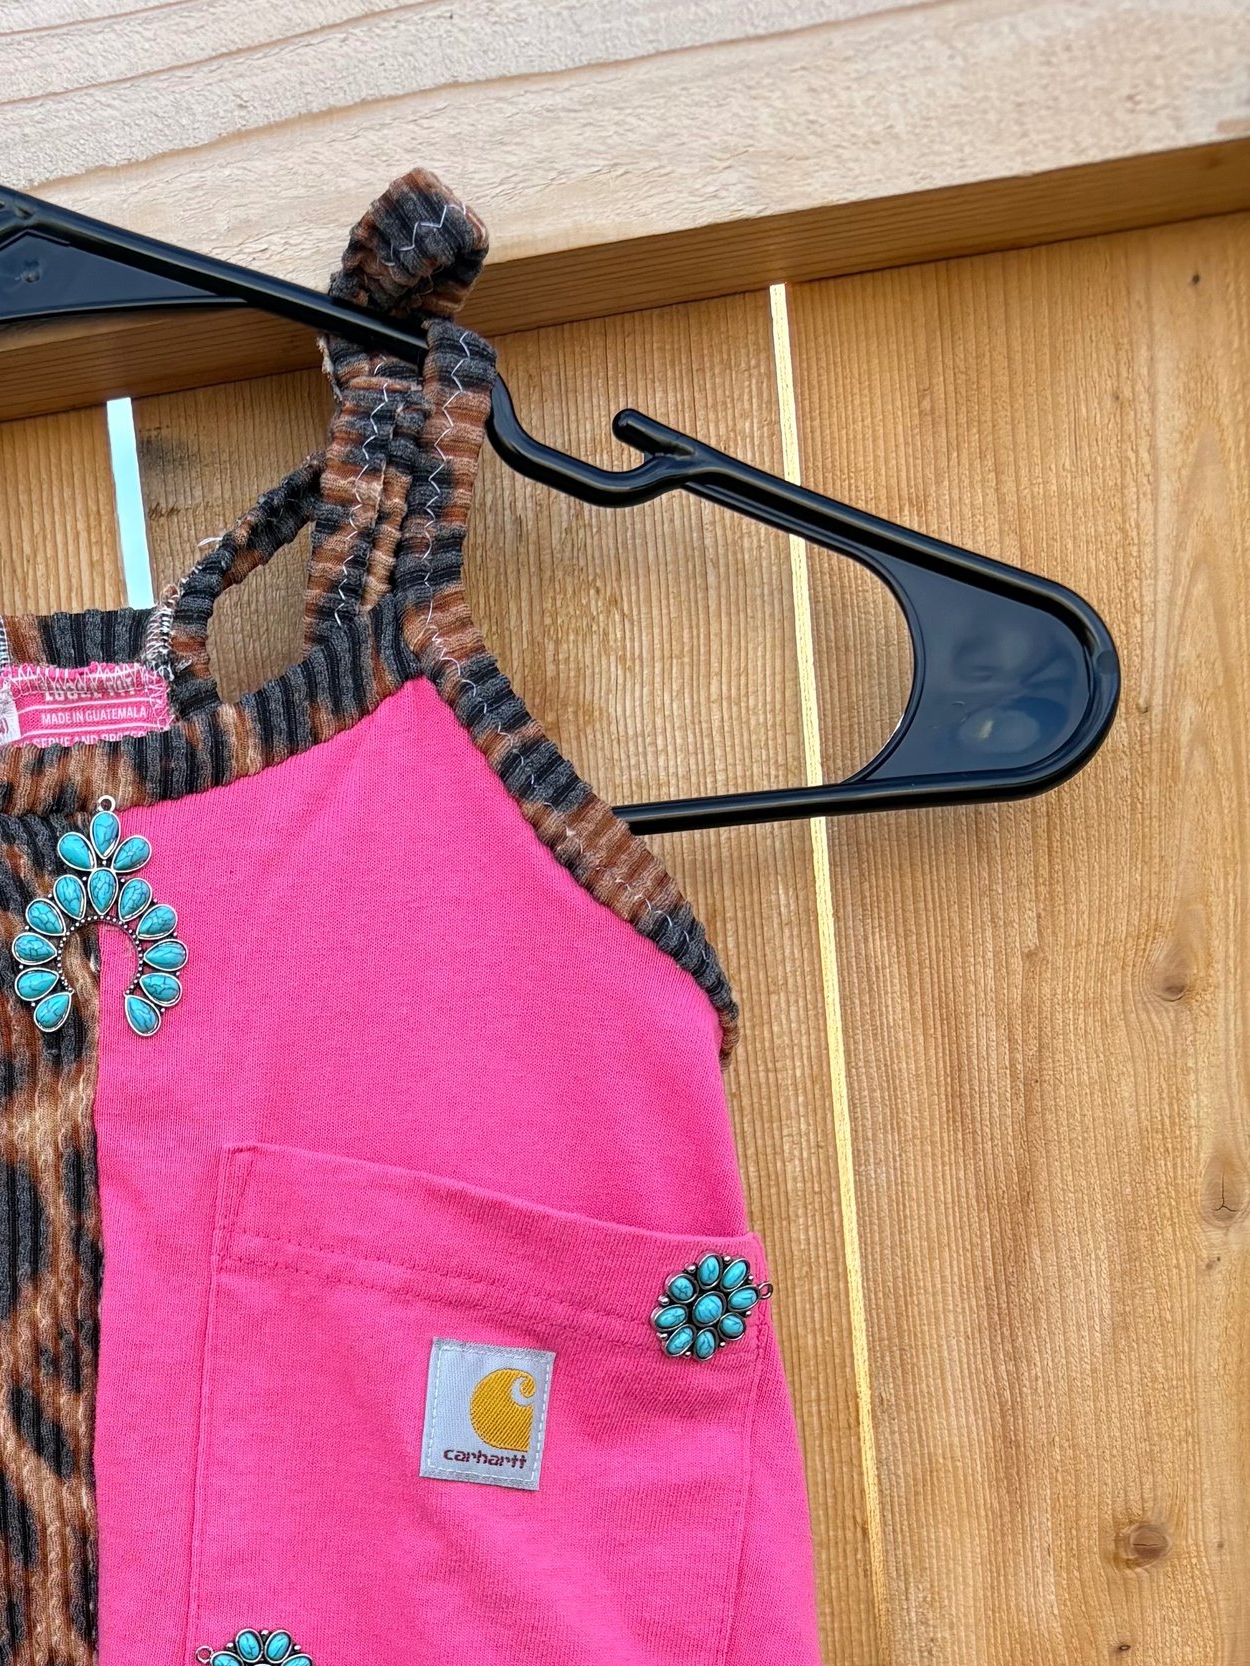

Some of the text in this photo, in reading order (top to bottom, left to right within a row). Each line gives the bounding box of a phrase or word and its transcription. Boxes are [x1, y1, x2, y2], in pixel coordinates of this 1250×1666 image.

[42, 706, 147, 725] MADE IN GUATEMALA
[443, 1449, 527, 1469] carhartt
